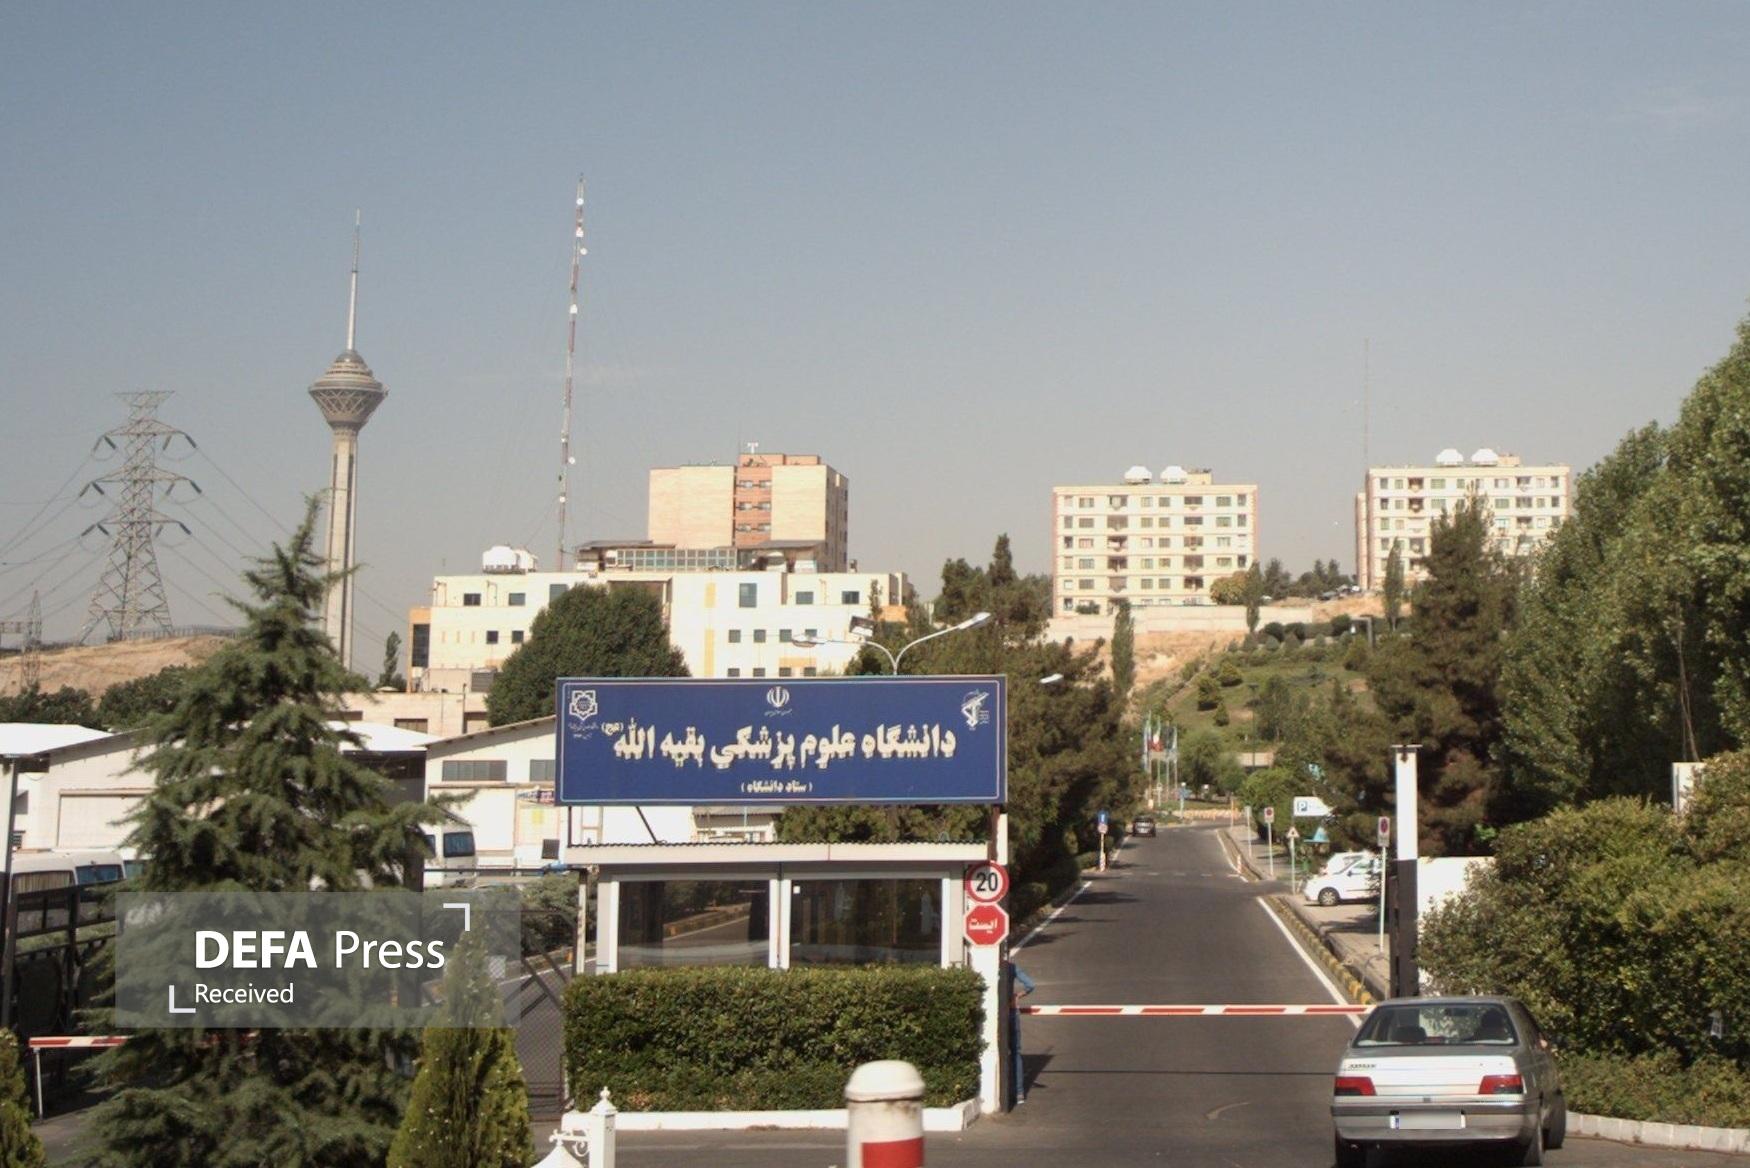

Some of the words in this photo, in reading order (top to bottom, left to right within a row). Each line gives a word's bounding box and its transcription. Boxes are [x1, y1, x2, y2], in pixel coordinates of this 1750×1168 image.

[613, 717, 656, 760] الله
[659, 725, 706, 768] بقیه
[710, 725, 795, 770] پزشکی
[800, 723, 856, 769] علوم
[861, 723, 957, 759] دانشگاه
[975, 872, 998, 892] 20
[968, 917, 998, 934] ایست
